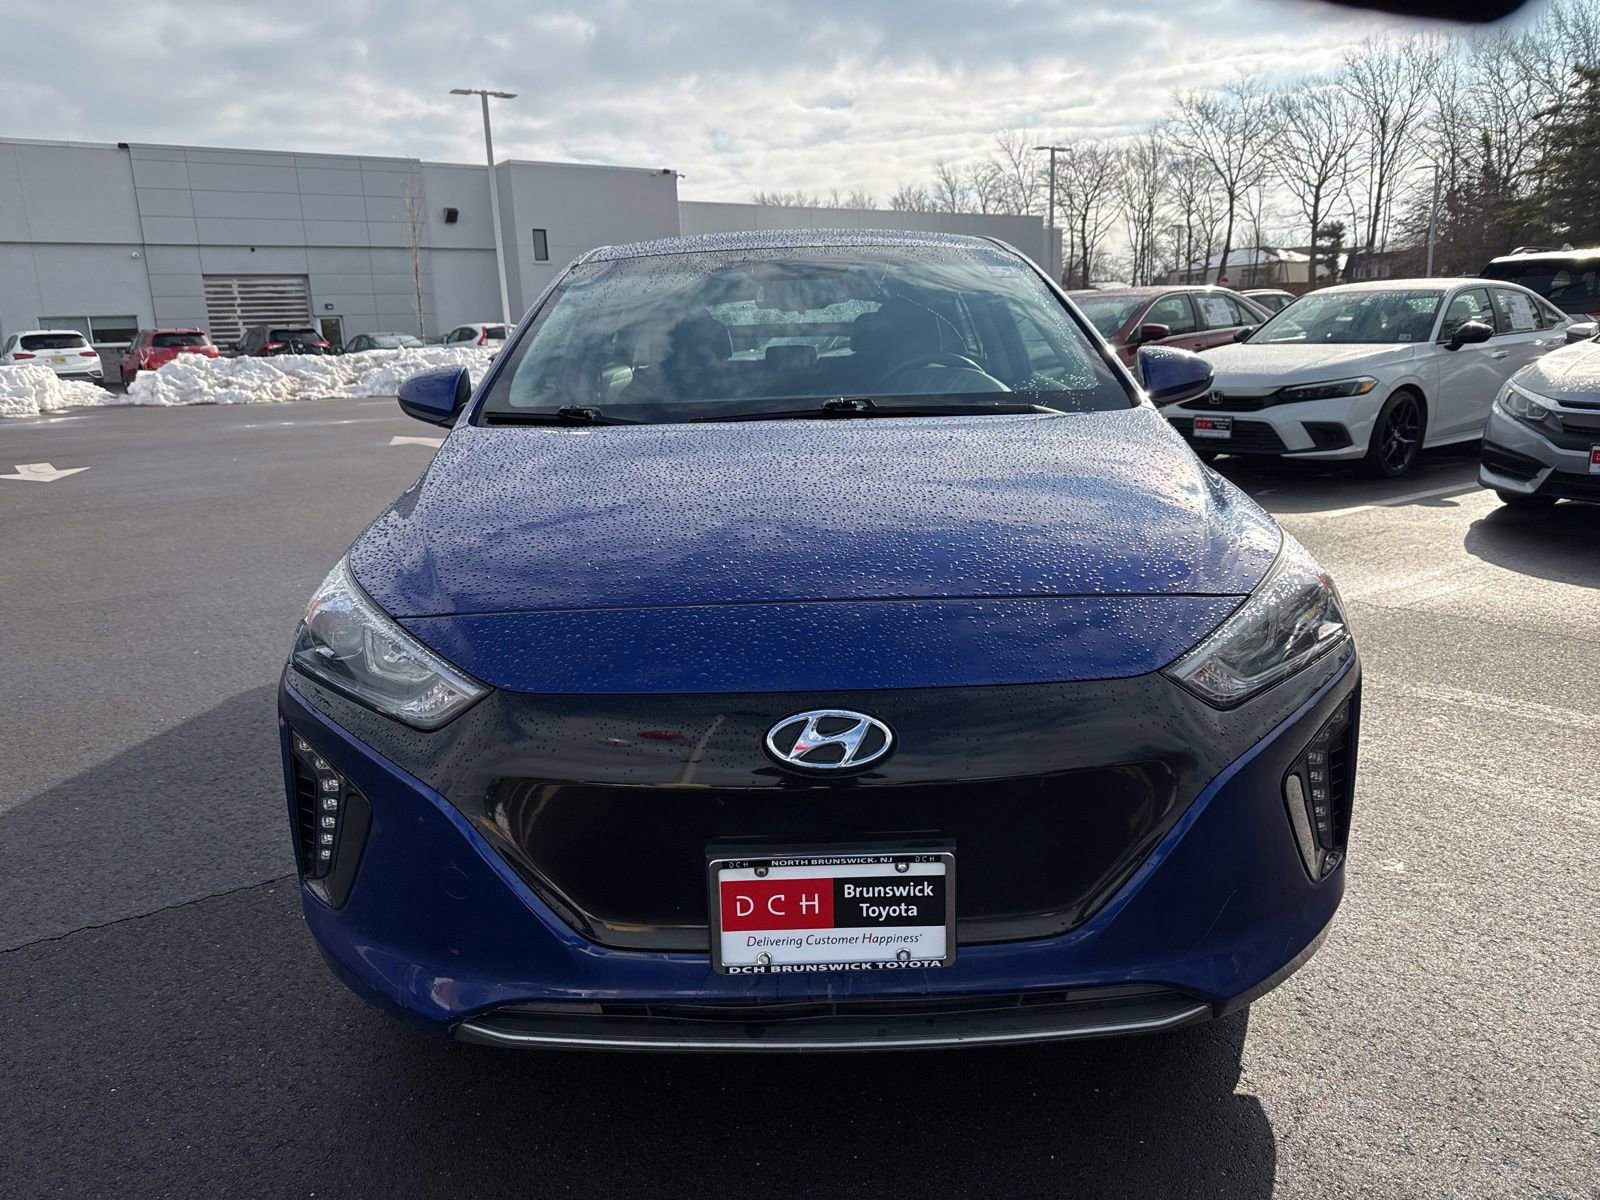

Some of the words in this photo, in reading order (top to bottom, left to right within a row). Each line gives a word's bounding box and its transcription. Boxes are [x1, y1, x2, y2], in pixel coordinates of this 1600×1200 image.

[771, 859, 809, 867] NORTH
[844, 881, 934, 898] Brunswick
[859, 903, 918, 922] Toyota
[746, 935, 803, 949] Delivering
[805, 934, 860, 946] Customer
[728, 966, 765, 974] DCH
[770, 961, 873, 973] BRUNSWICK
[875, 960, 941, 969] TOYOTA
